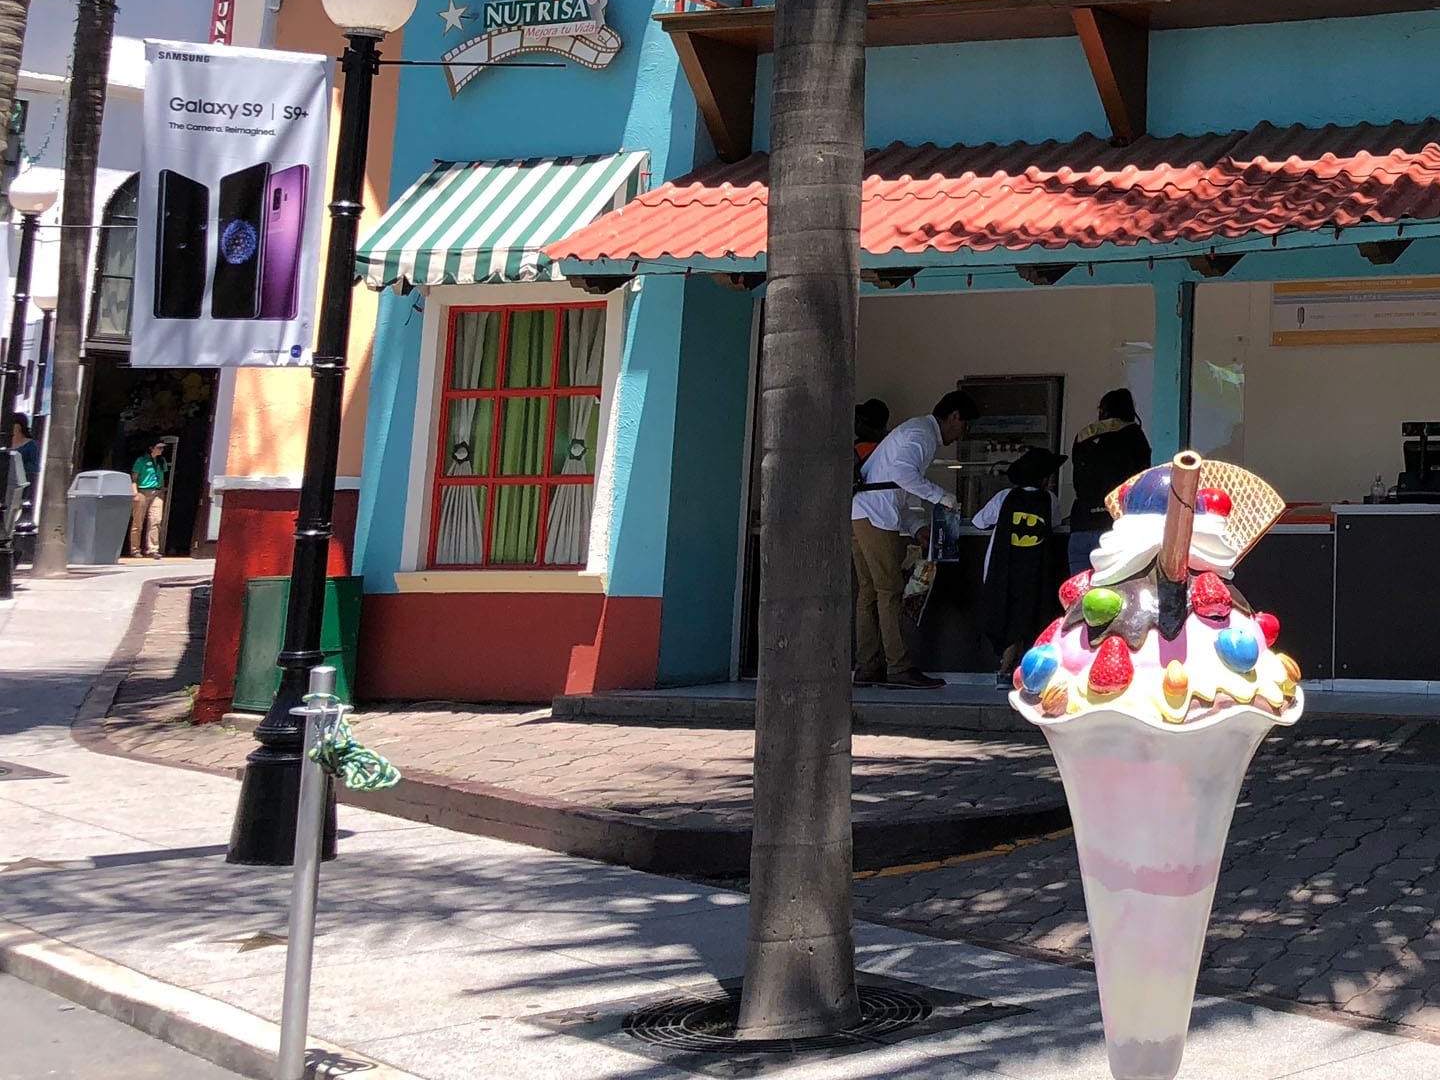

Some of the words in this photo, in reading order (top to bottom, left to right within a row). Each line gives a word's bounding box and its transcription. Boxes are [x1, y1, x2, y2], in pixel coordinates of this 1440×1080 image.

[525, 25, 559, 41] Mejora
[560, 25, 572, 35] tu
[573, 22, 597, 34] Vida
[158, 51, 210, 64] SAMSUNG
[169, 96, 239, 120] Galaxy
[242, 102, 264, 118] S9
[283, 105, 309, 121] S9+
[168, 121, 185, 131] The
[186, 122, 224, 133] Camera.
[225, 125, 276, 137] Reimagined.
